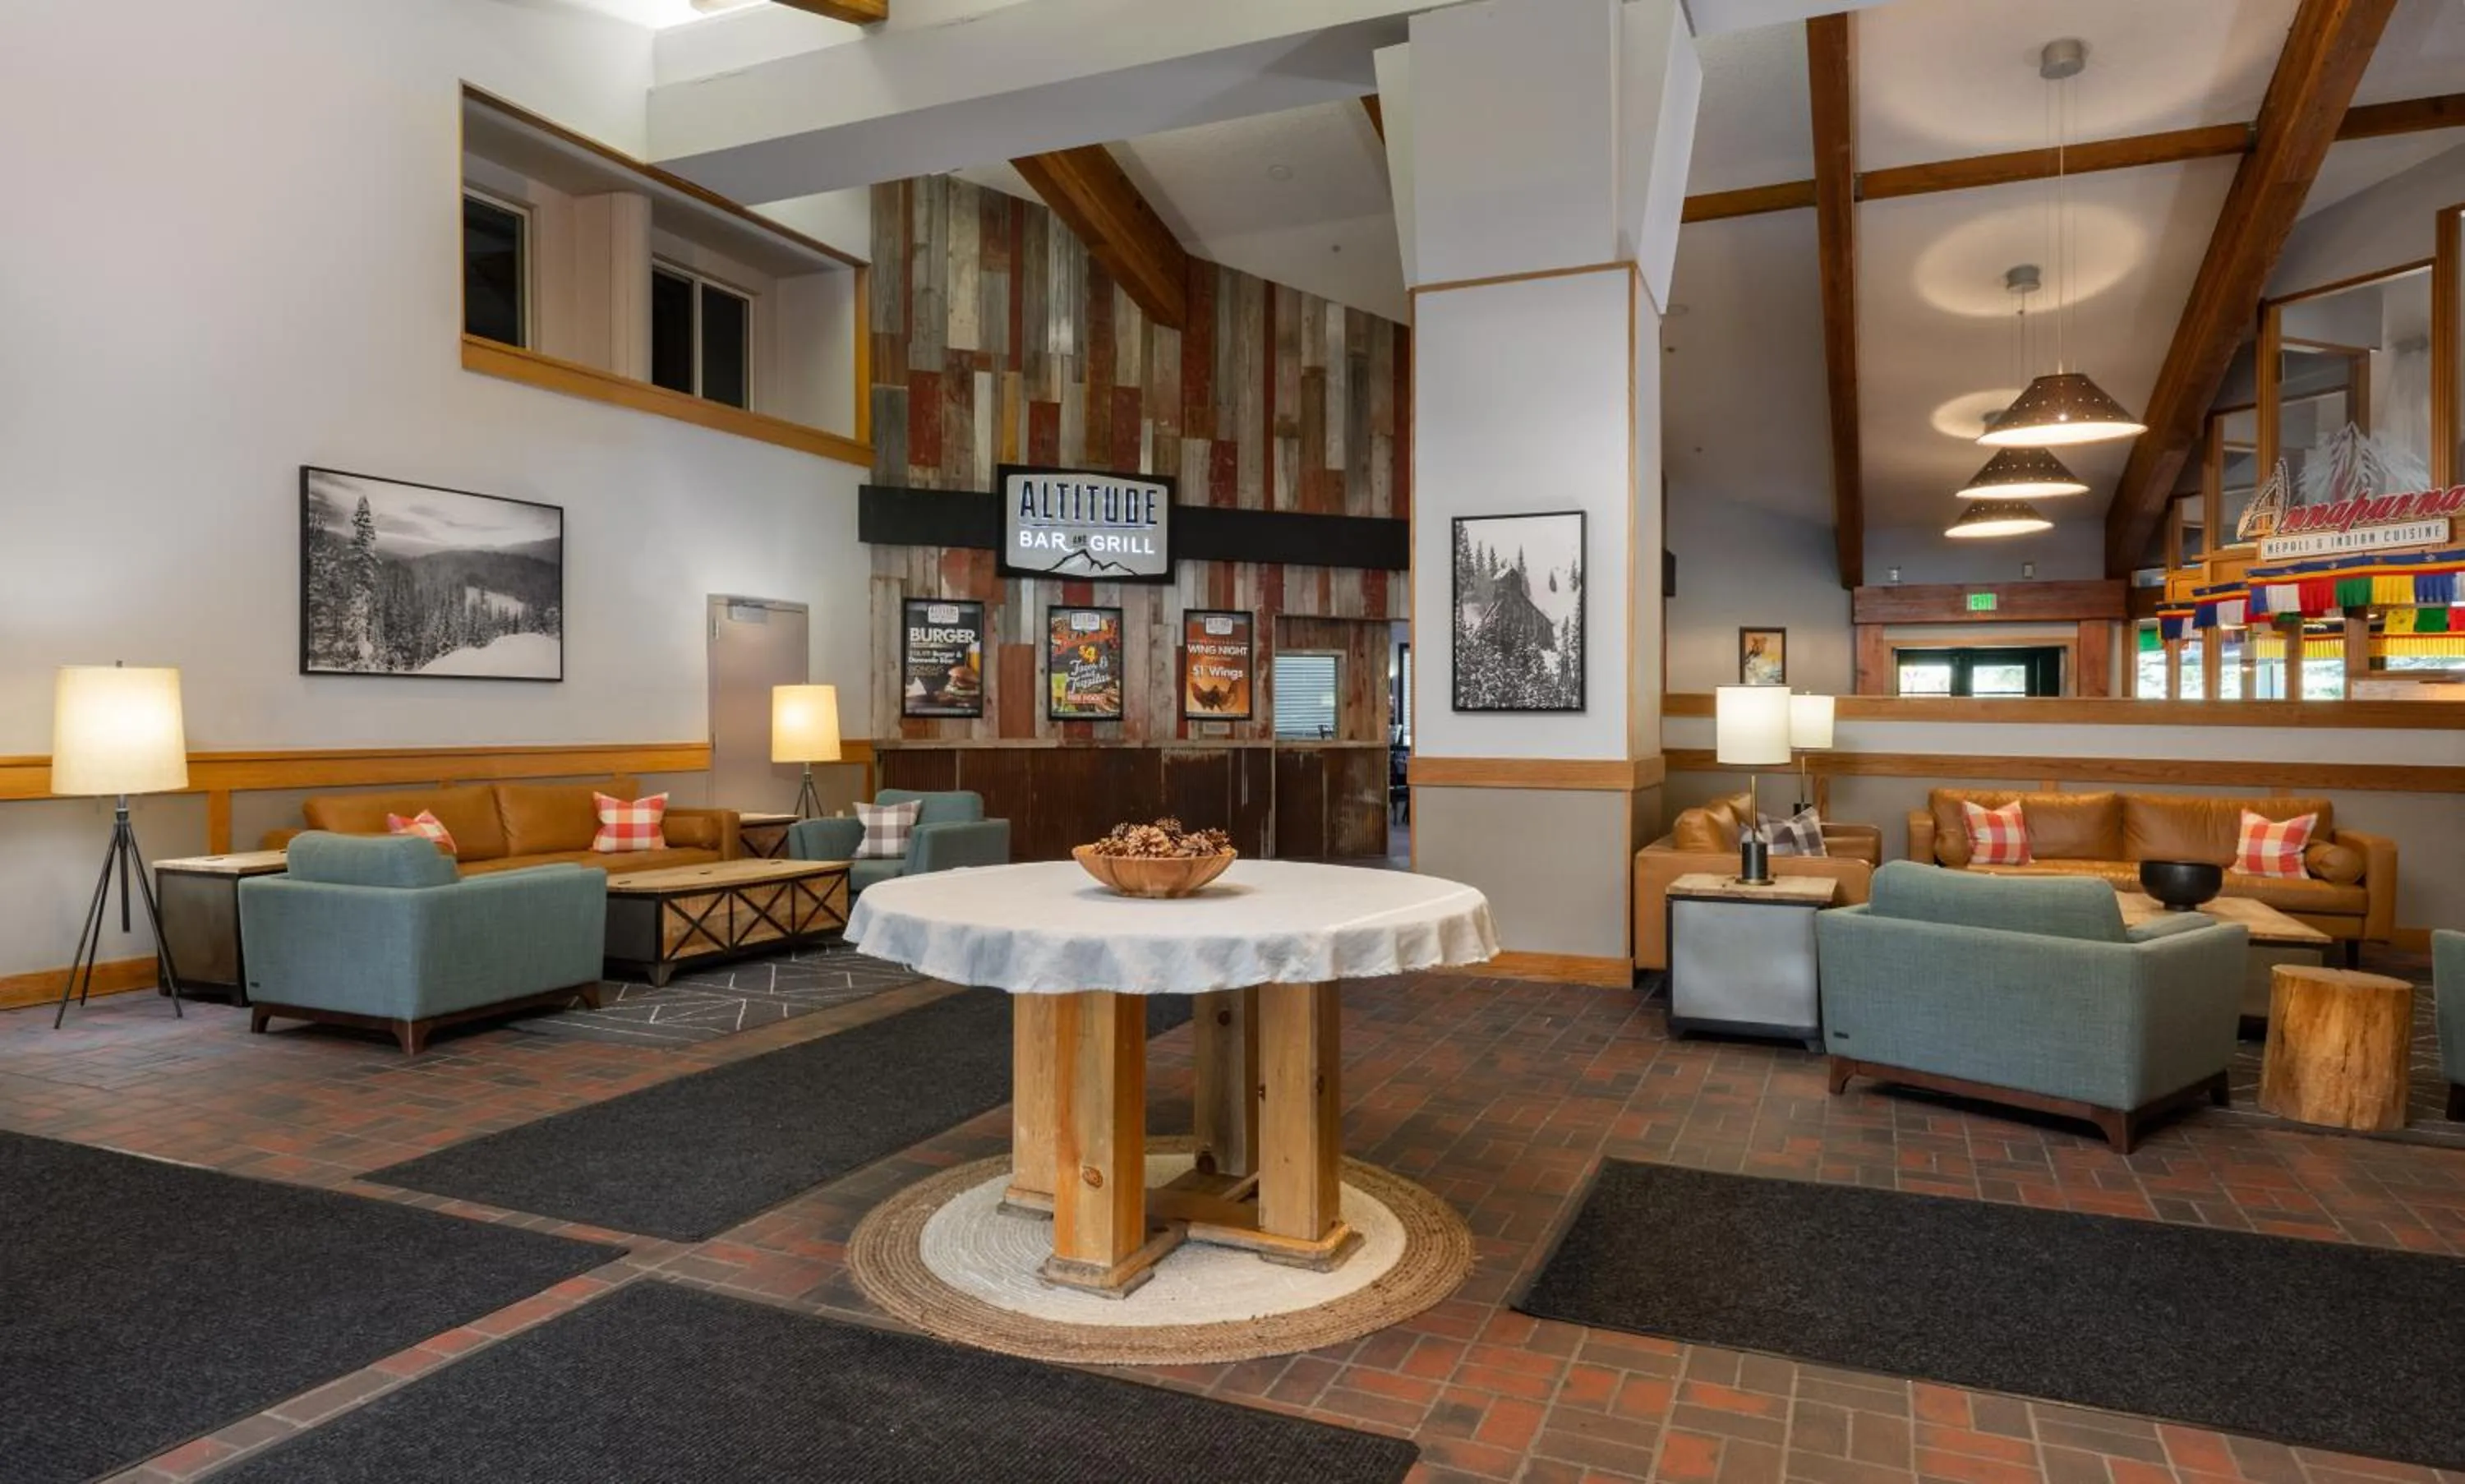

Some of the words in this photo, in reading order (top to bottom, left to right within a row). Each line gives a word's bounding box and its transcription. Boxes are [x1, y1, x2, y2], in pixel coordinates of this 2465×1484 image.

[1019, 480, 1159, 526] ALTITUDE
[2384, 524, 2442, 543] CUISINE
[1020, 531, 1074, 553] BAR
[1090, 534, 1156, 555] GRILL
[910, 627, 976, 644] BURGER
[1186, 643, 1217, 656] WING
[1218, 645, 1249, 657] NIGHT
[1208, 665, 1244, 680] Wings
